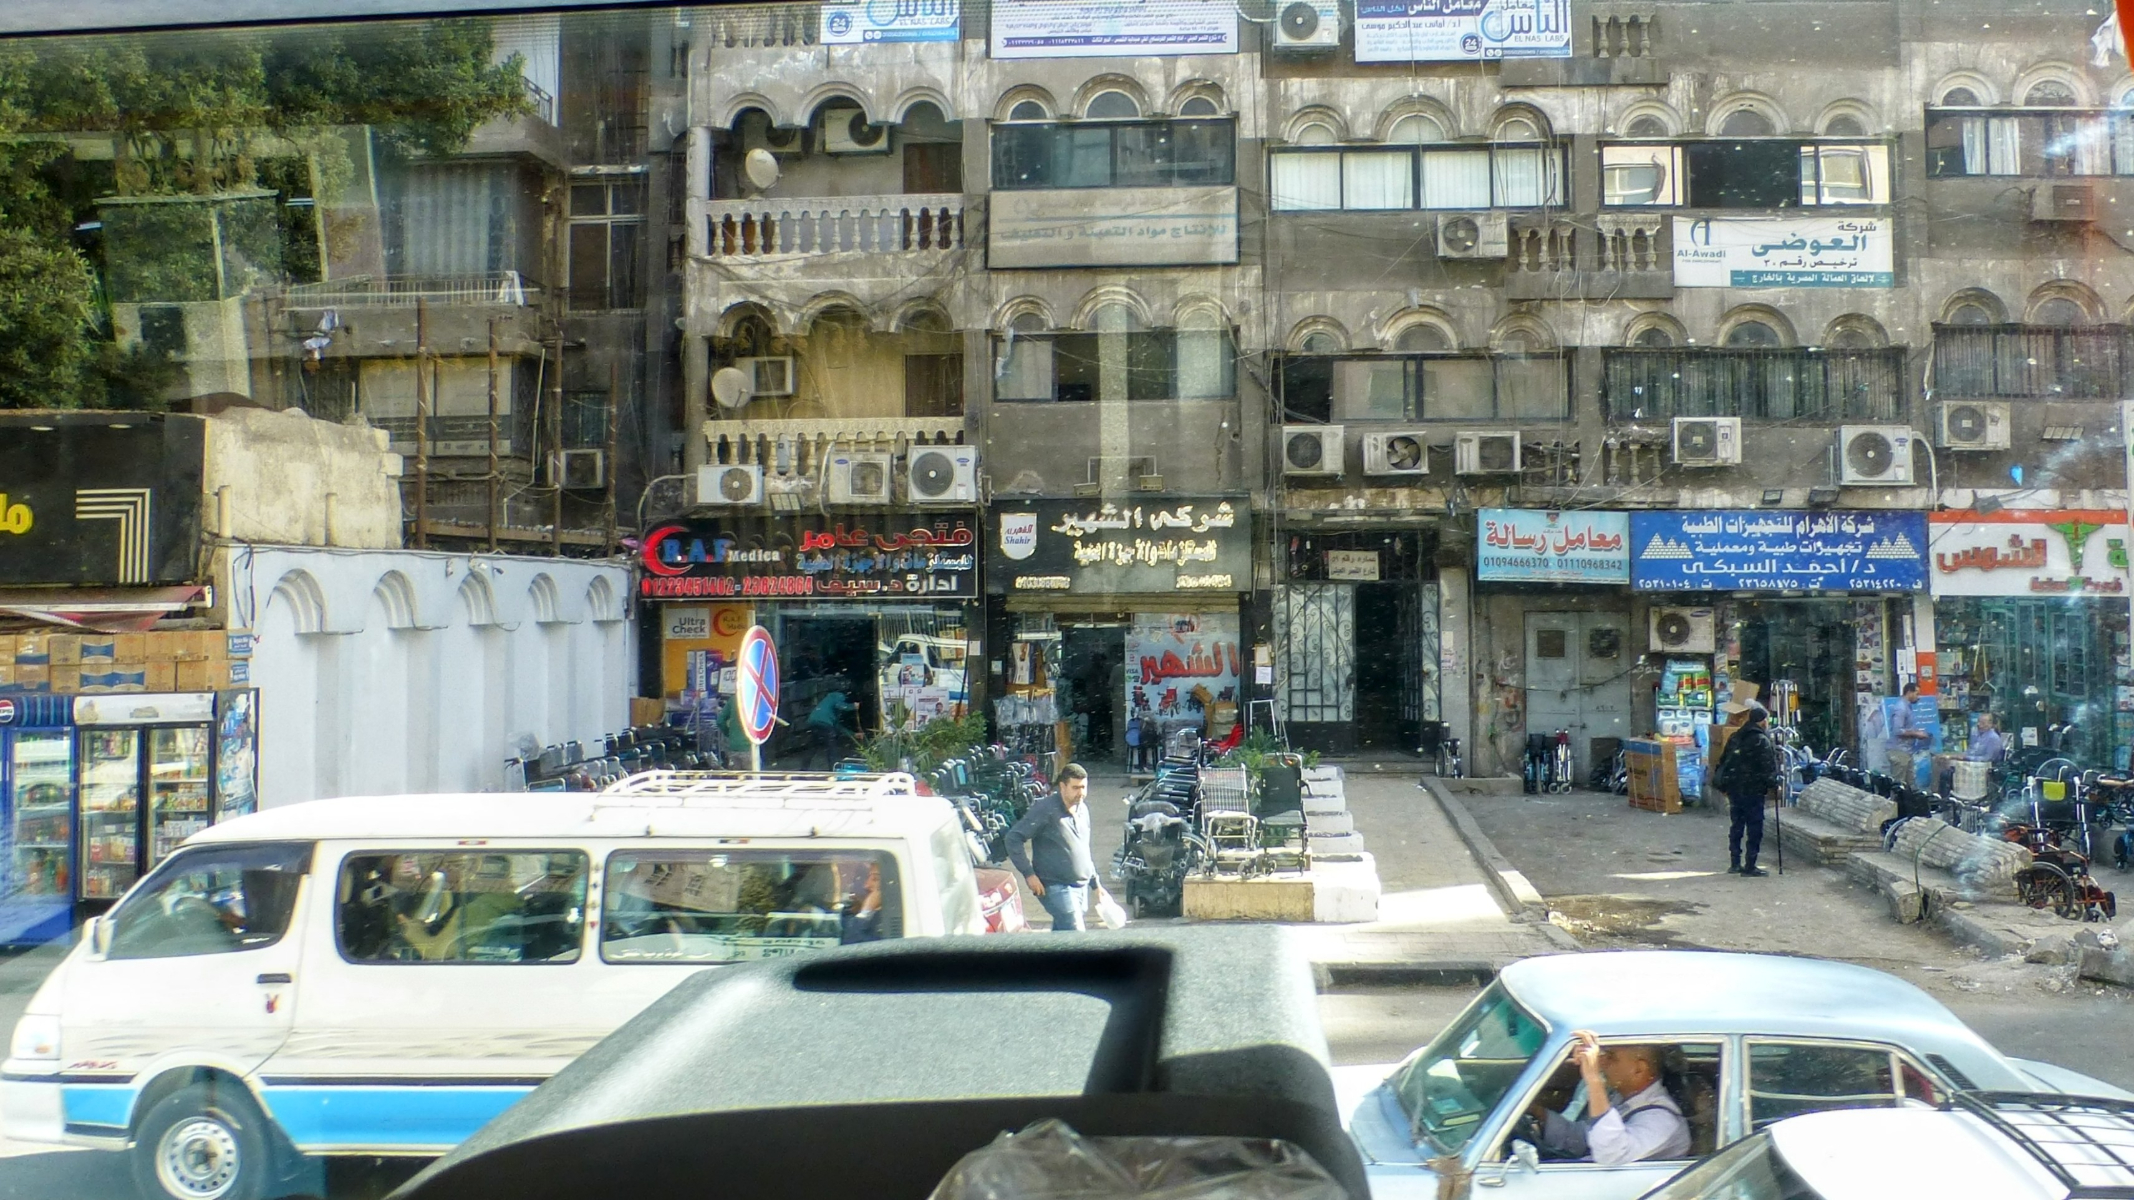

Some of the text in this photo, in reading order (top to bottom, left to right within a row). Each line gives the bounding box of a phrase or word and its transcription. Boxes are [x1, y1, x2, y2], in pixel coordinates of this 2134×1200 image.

[1838, 221, 1877, 232] شركة
[1677, 249, 1727, 258] Al-Awadi
[1780, 257, 1806, 270] رقم
[1809, 259, 1857, 270] ترخيص
[1751, 274, 1783, 284] بالخارج
[1786, 274, 1818, 284] المصرية
[1821, 274, 1848, 283] العمالة
[1051, 503, 1144, 537] الشهير
[1682, 515, 1722, 537] الطبية
[1725, 514, 1793, 537] للتجهيزات
[1841, 514, 1875, 537] شركة
[799, 523, 869, 551] عامر
[1004, 536, 1031, 545] Shahir
[1485, 520, 1623, 556] معامل رسالة
[1695, 540, 1863, 556] تجهيزات طبية ومعملية
[1483, 556, 1549, 568] 01094666370
[679, 617, 706, 626] Ultra
[672, 625, 706, 634] Check
[1140, 641, 1240, 685] الشهير
